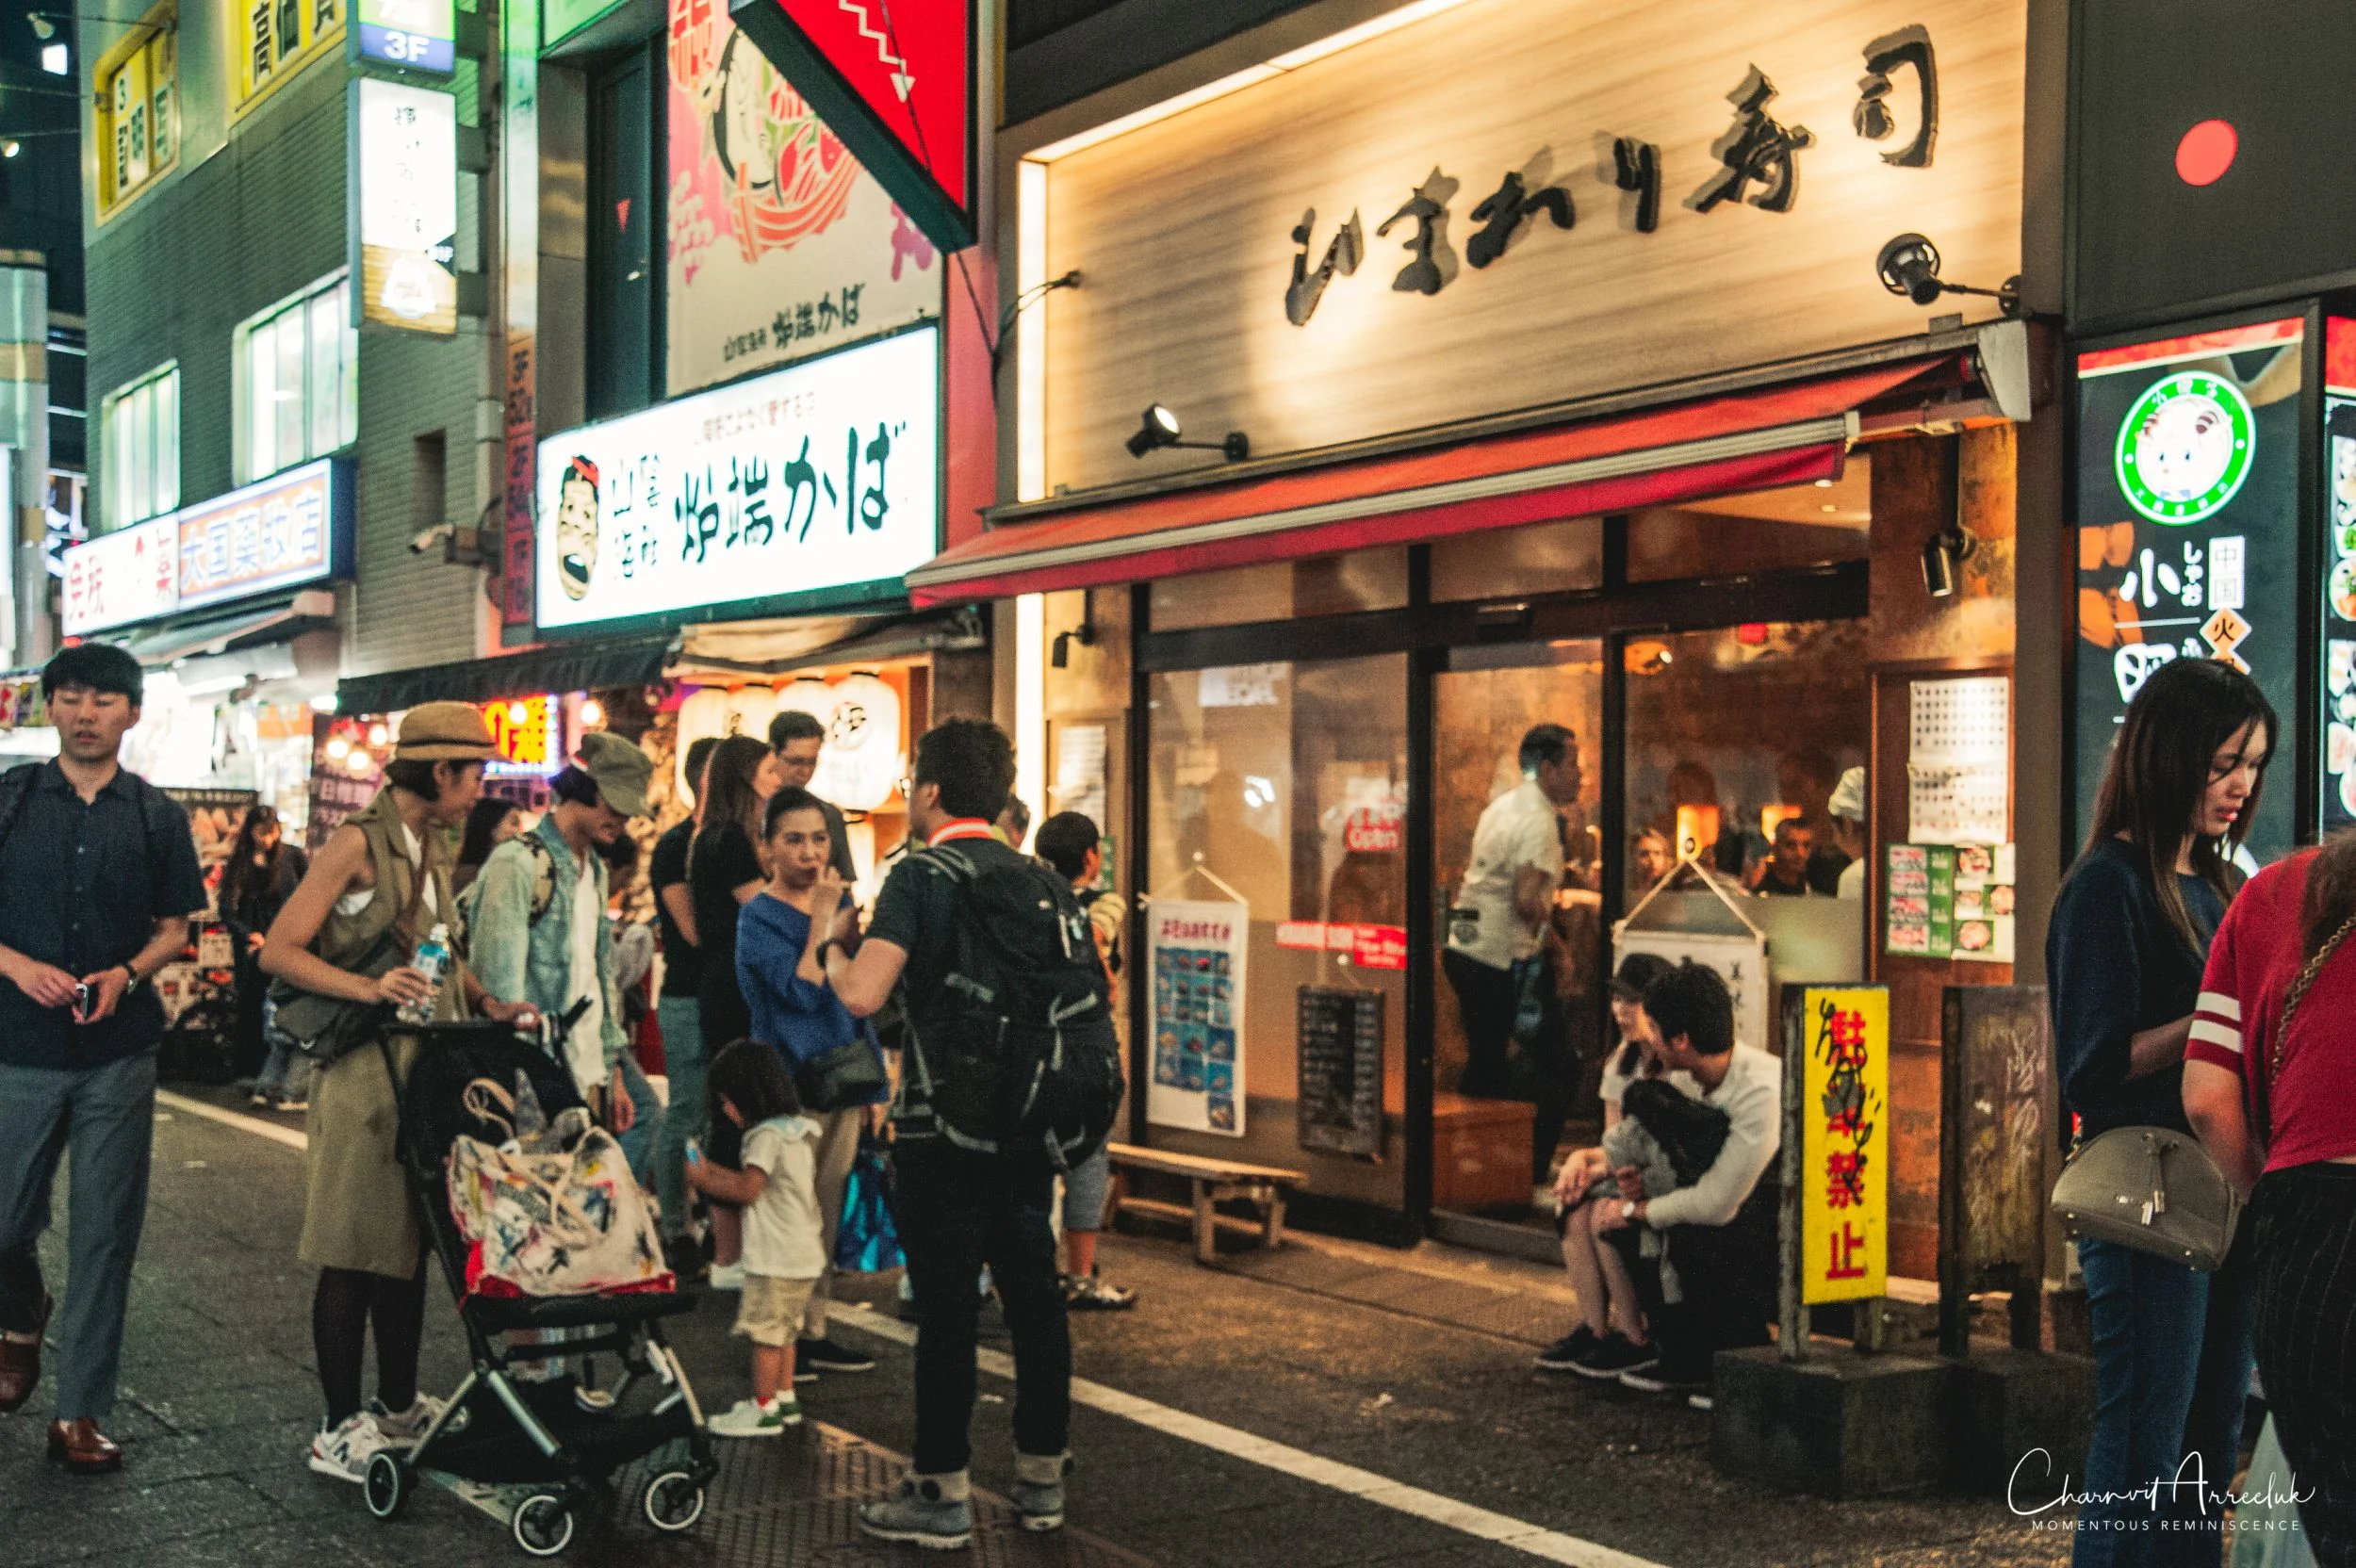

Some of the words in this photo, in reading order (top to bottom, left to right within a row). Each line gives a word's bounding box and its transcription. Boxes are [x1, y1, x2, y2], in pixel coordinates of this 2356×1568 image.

[384, 30, 429, 61] 3F
[1285, 24, 1939, 327] ひまわり寿司
[675, 419, 907, 565] 炉端かば
